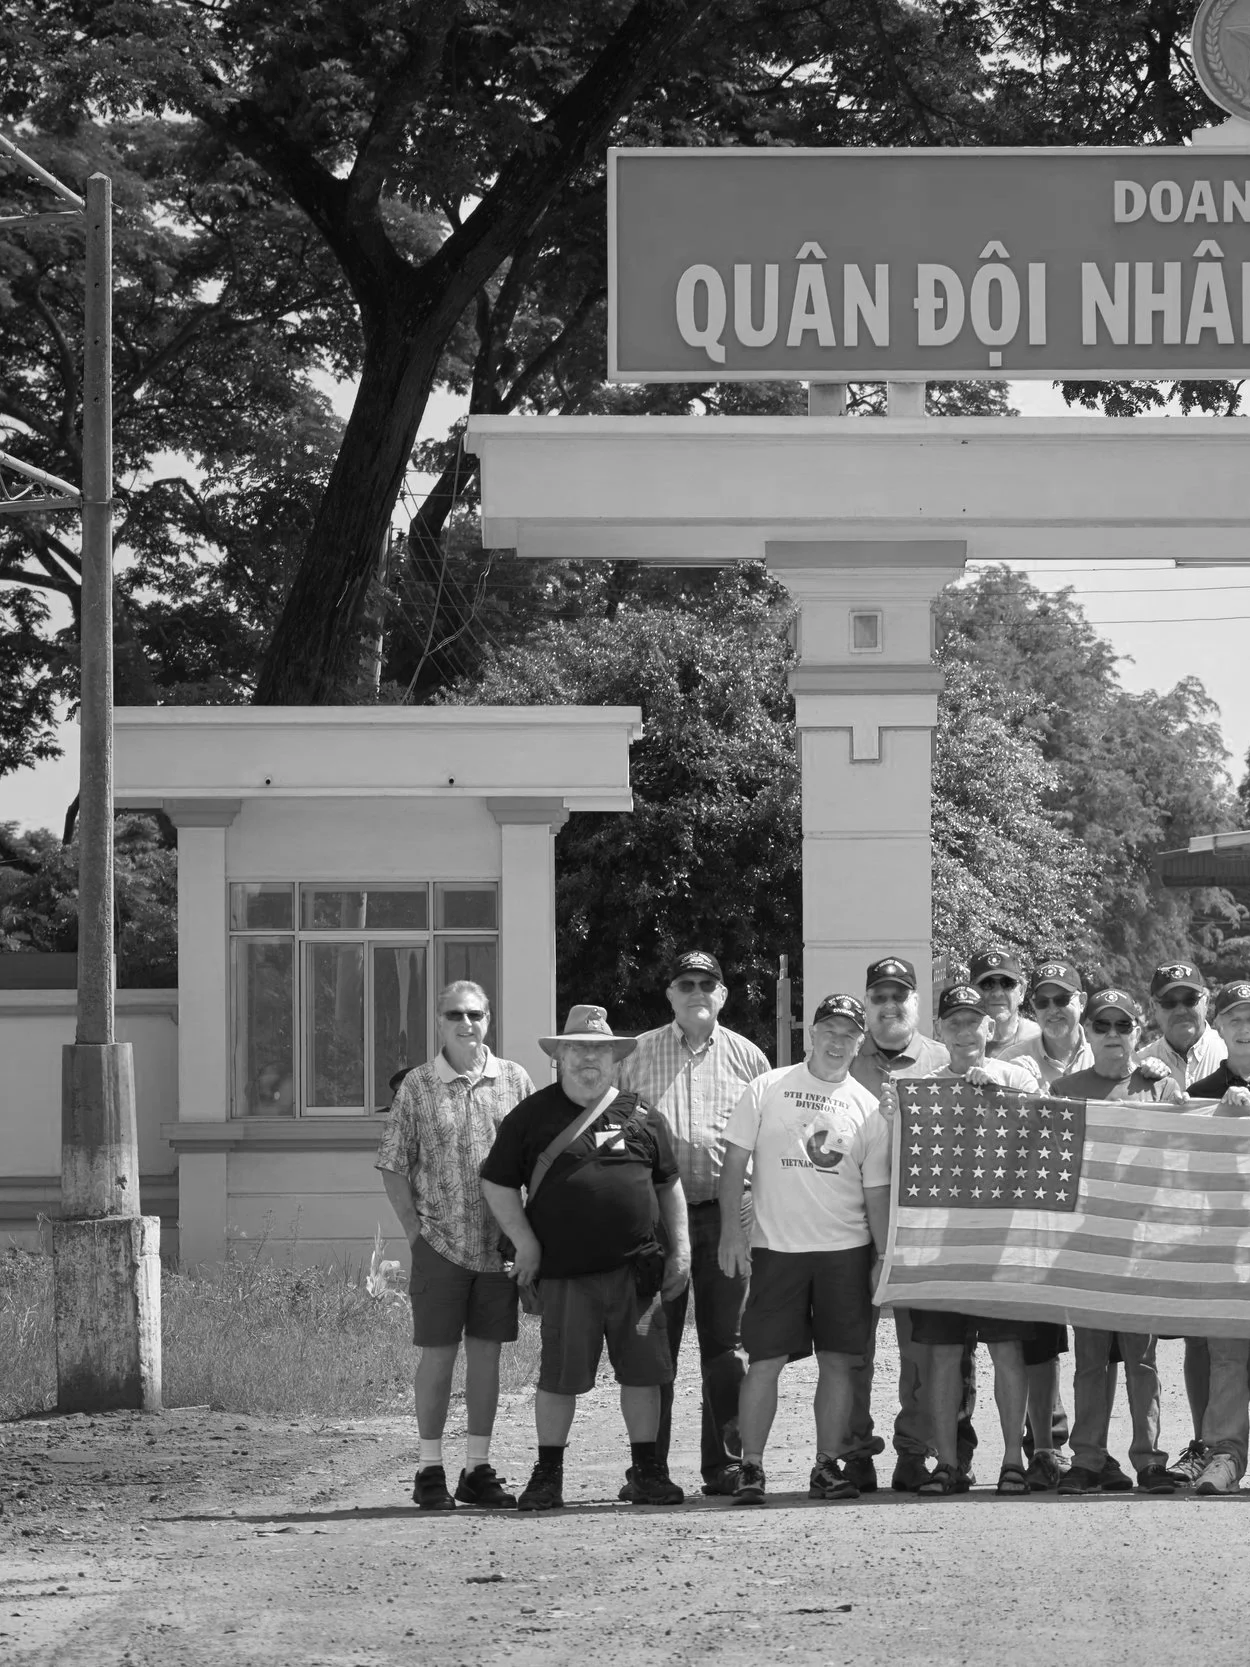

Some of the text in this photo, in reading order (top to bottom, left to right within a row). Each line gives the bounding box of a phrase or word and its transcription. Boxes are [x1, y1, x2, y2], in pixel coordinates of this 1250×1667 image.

[675, 241, 889, 364] QUÂN
[913, 241, 1046, 367] ĐỘI
[784, 1091, 849, 1110] 9TH INFANTRY
[796, 1100, 836, 1114] DIVISION
[781, 1158, 814, 1169] VIETNAM
